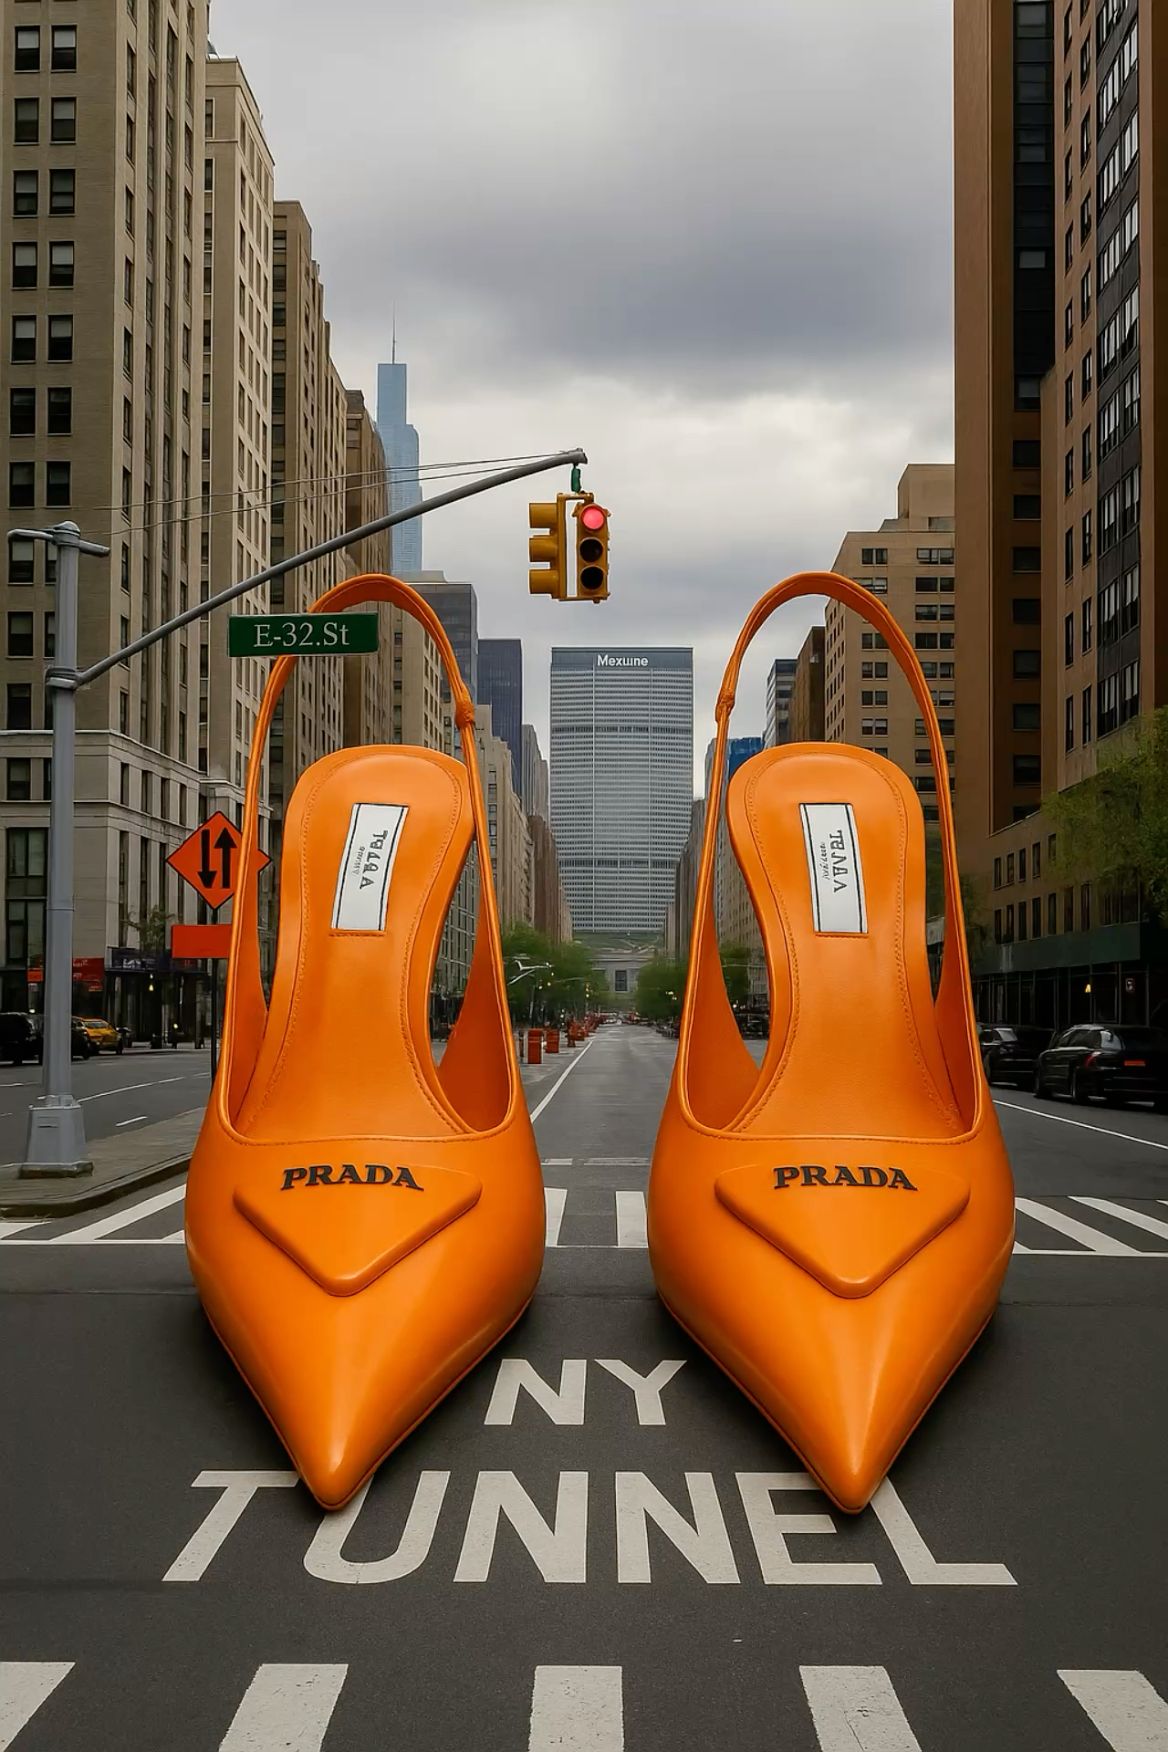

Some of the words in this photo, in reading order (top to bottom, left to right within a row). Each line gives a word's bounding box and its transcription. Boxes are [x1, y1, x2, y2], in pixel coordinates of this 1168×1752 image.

[280, 1164, 424, 1191] PRADA
[773, 1165, 918, 1191] PRADA
[484, 1358, 687, 1425] NY
[162, 1470, 1017, 1585] TUNNEL
